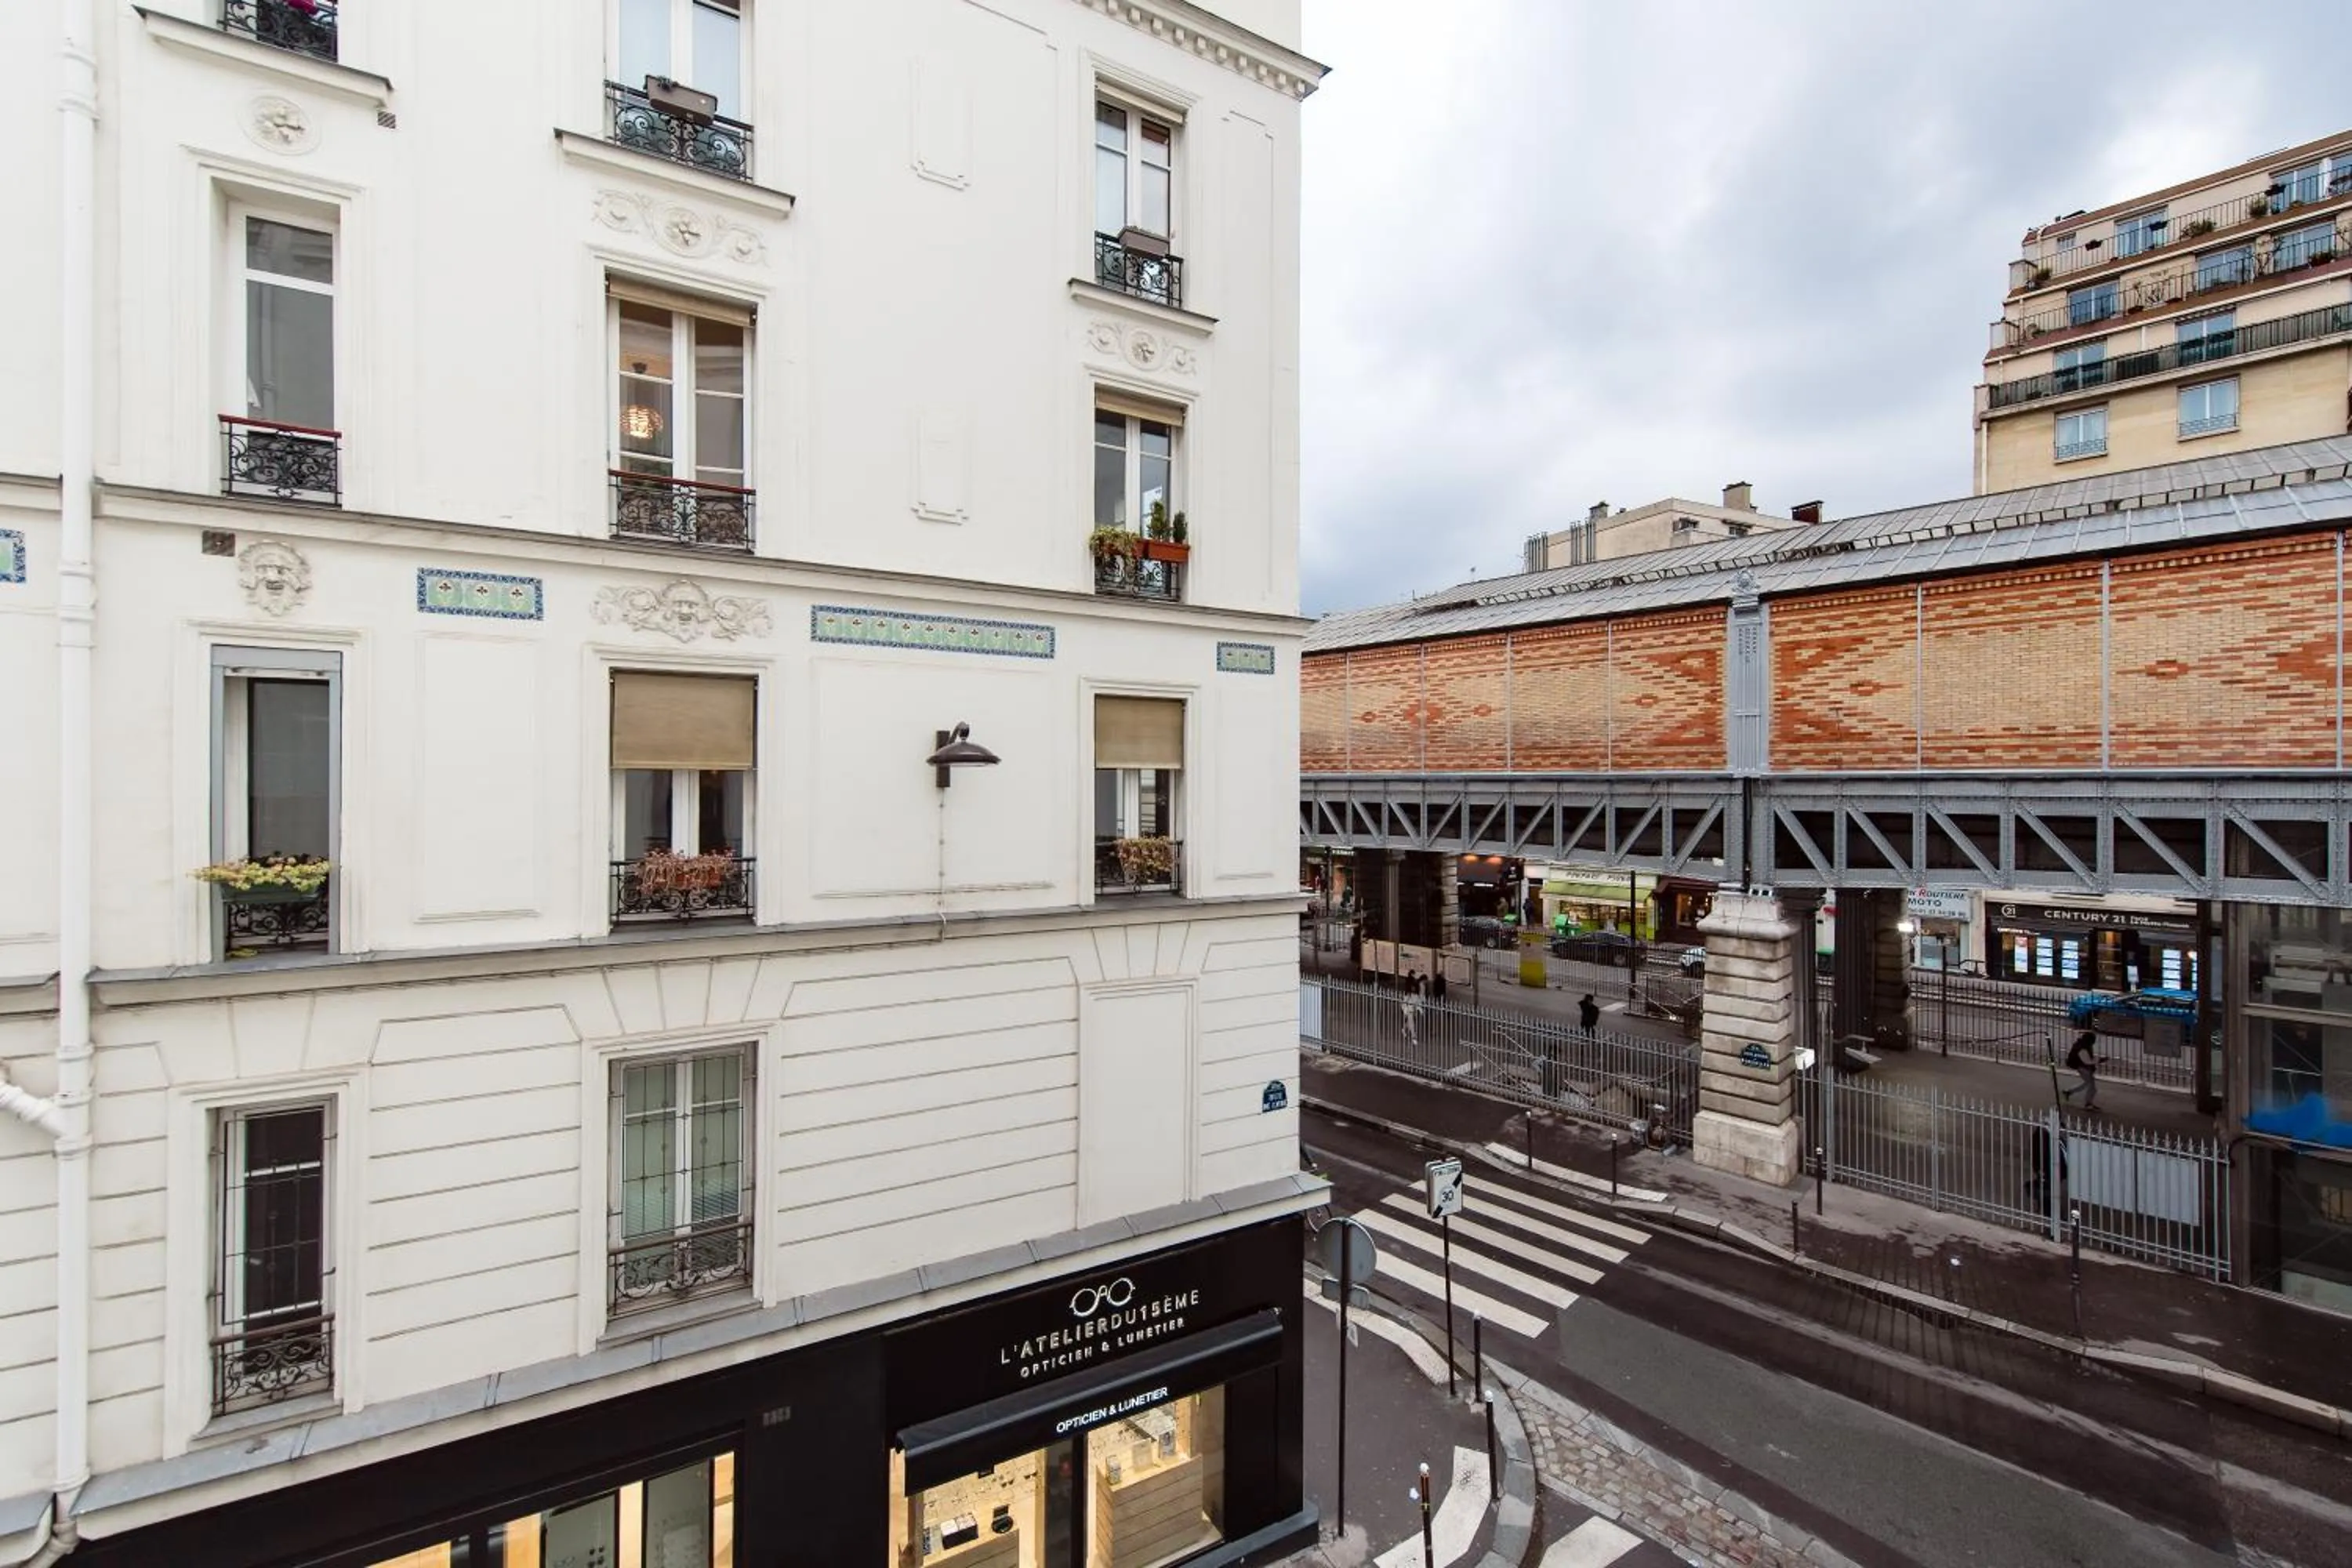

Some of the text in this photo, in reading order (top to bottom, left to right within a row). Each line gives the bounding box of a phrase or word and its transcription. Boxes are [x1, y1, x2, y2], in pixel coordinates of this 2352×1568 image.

[1907, 898, 1942, 907] MOTO
[2044, 909, 2108, 922] CENTURY
[2112, 914, 2126, 924] 21
[1442, 1189, 1454, 1203] 30
[1020, 1317, 1185, 1378] OPTICIEN & LUNETIER
[1056, 1387, 1168, 1433] OPTICIEN & LUNETIER
